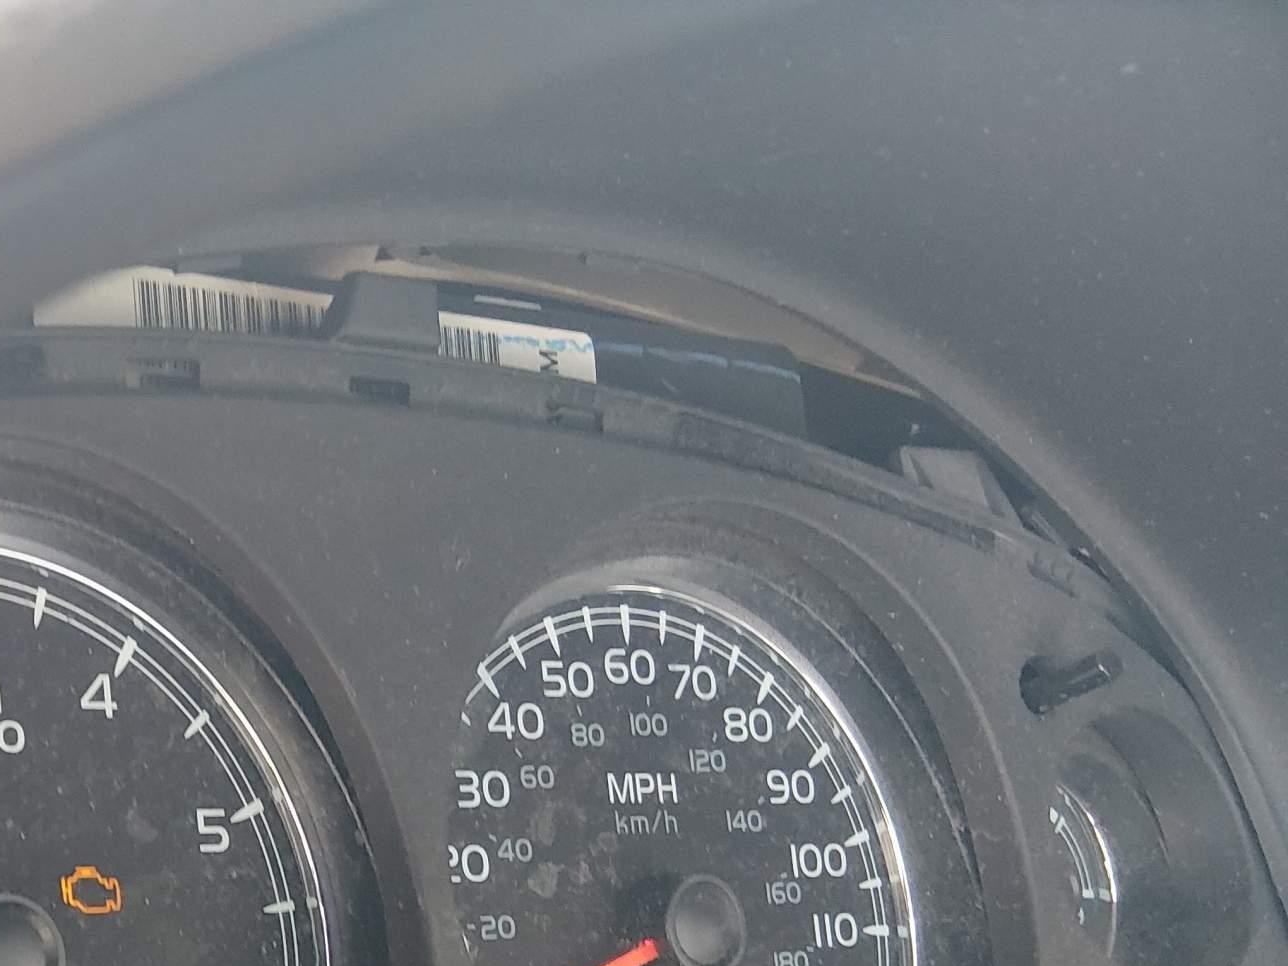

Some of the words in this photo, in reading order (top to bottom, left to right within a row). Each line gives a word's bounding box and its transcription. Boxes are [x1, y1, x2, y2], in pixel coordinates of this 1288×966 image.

[540, 660, 595, 699] 50
[603, 648, 656, 686] 60
[667, 664, 718, 701] 70
[80, 673, 119, 720] 4
[487, 702, 545, 741] 40
[570, 722, 606, 748] 80
[628, 712, 669, 737] 100
[723, 706, 774, 743] 80
[519, 764, 555, 790] 60
[688, 748, 727, 774] 120
[455, 769, 511, 808] 30
[607, 772, 679, 805] MPH
[766, 769, 816, 805] 90
[195, 807, 231, 854] 5
[614, 810, 680, 836] km/h
[725, 809, 764, 834] 140
[497, 838, 533, 862] 40
[789, 843, 848, 879] 100
[765, 881, 802, 905] 160
[479, 914, 516, 940] 20
[812, 911, 859, 949] 110
